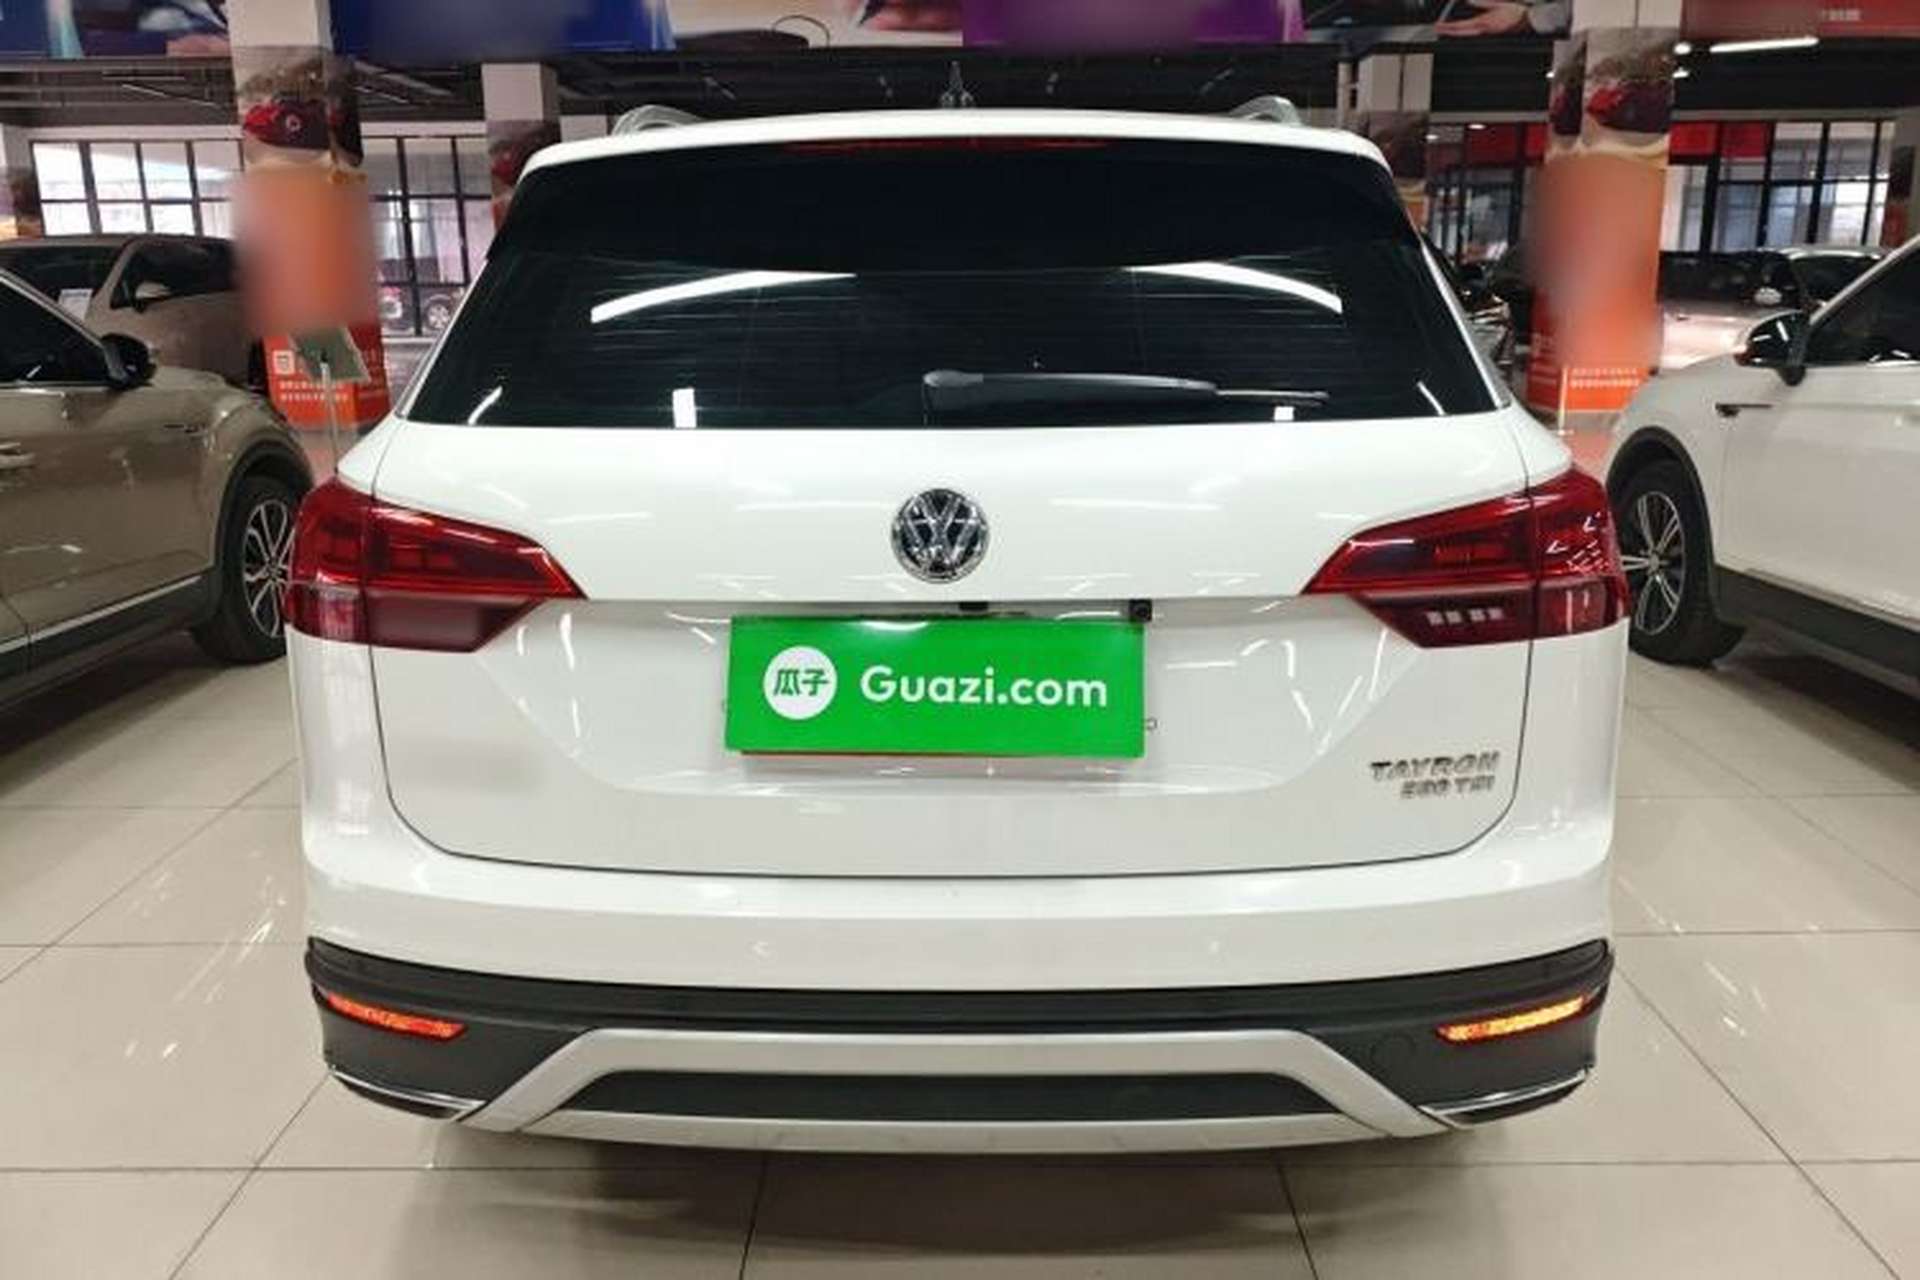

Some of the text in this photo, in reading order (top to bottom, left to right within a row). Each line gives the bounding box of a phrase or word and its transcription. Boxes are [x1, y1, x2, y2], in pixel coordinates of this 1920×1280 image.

[773, 668, 828, 697] 瓜子
[860, 665, 1107, 707] Guazi.com
[1370, 750, 1500, 781] TAYRON
